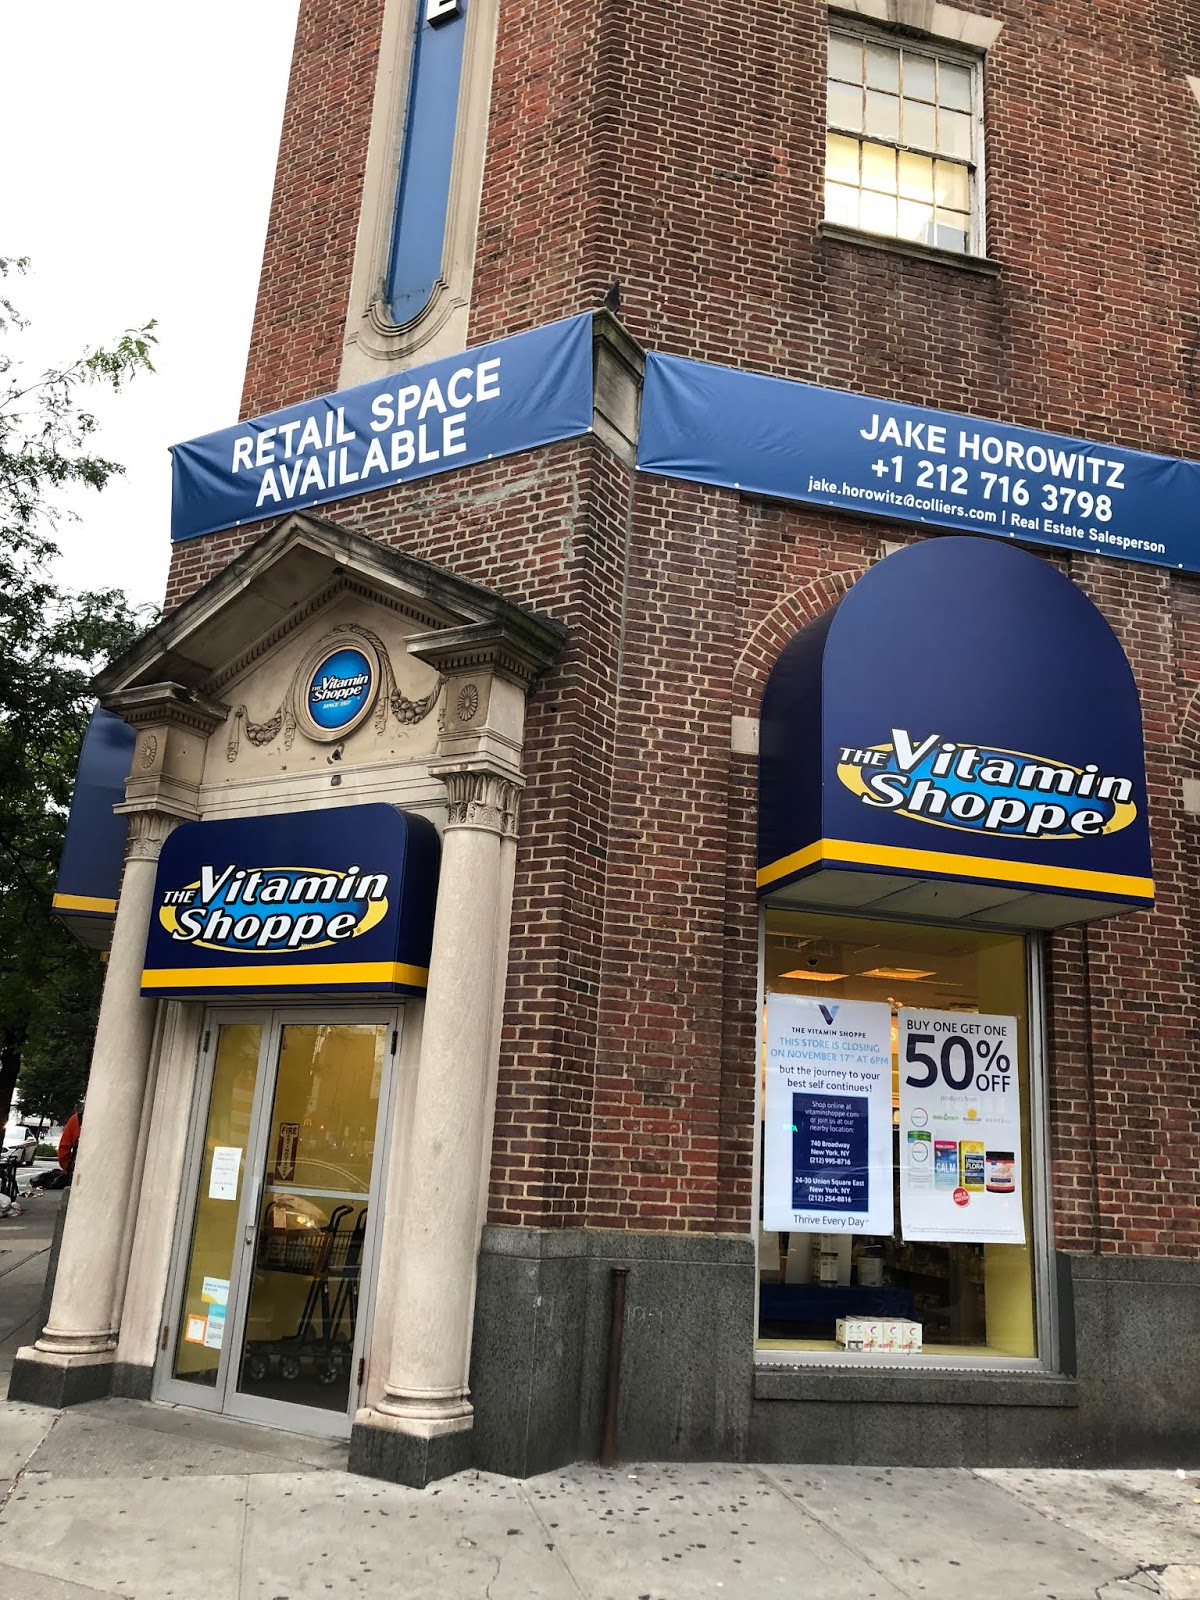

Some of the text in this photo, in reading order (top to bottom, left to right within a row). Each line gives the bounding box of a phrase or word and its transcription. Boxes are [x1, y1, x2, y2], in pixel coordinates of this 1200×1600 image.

[231, 357, 501, 474] RETAIL SPACE
[255, 412, 467, 508] AVAILABLE
[859, 413, 1126, 490] JAKE HOROWITZ
[871, 455, 1113, 522] +1 212 716 3798
[807, 475, 997, 523] jake.horowitz@colliers.com
[1010, 513, 1039, 531] Real
[1043, 520, 1084, 538] Estate
[1088, 529, 1166, 554] Salesperson
[322, 673, 369, 690] Vitamin
[312, 685, 362, 702] Shoppe
[840, 728, 1133, 801] THE Vitamin
[861, 773, 1104, 834] Shoppe
[164, 864, 389, 904] THE Vitamin
[172, 908, 357, 947] Shoppe
[808, 1028, 837, 1036] VITAMIN
[839, 1030, 866, 1039] SHOPPE
[907, 1019, 1007, 1037] BUY ONE GET ONE
[780, 1037, 880, 1053] THIS STORE IS CLOSING
[770, 1048, 785, 1058] ON
[787, 1049, 837, 1061] NOVEMBER
[869, 1056, 889, 1065] 6PM
[905, 1033, 1011, 1091] 50%
[779, 1064, 881, 1082] but the journey to your
[787, 1077, 873, 1093] best self continues!
[976, 1073, 1011, 1093] OFF
[812, 1100, 827, 1109] Shop
[827, 1102, 845, 1110] online
[281, 1126, 298, 1135] FIRE
[810, 1125, 829, 1133] nearby
[810, 1139, 850, 1150] 740 Broadway
[810, 1148, 824, 1156] New
[825, 1149, 840, 1157] York,
[936, 1162, 957, 1174] CALM
[965, 1162, 985, 1171] FLORA
[794, 1176, 865, 1187] 24-30 Union Square East
[808, 1194, 824, 1203] (212)
[809, 1186, 850, 1195] New York, NY
[793, 1214, 821, 1225] Thrive
[822, 1215, 846, 1228] Every
